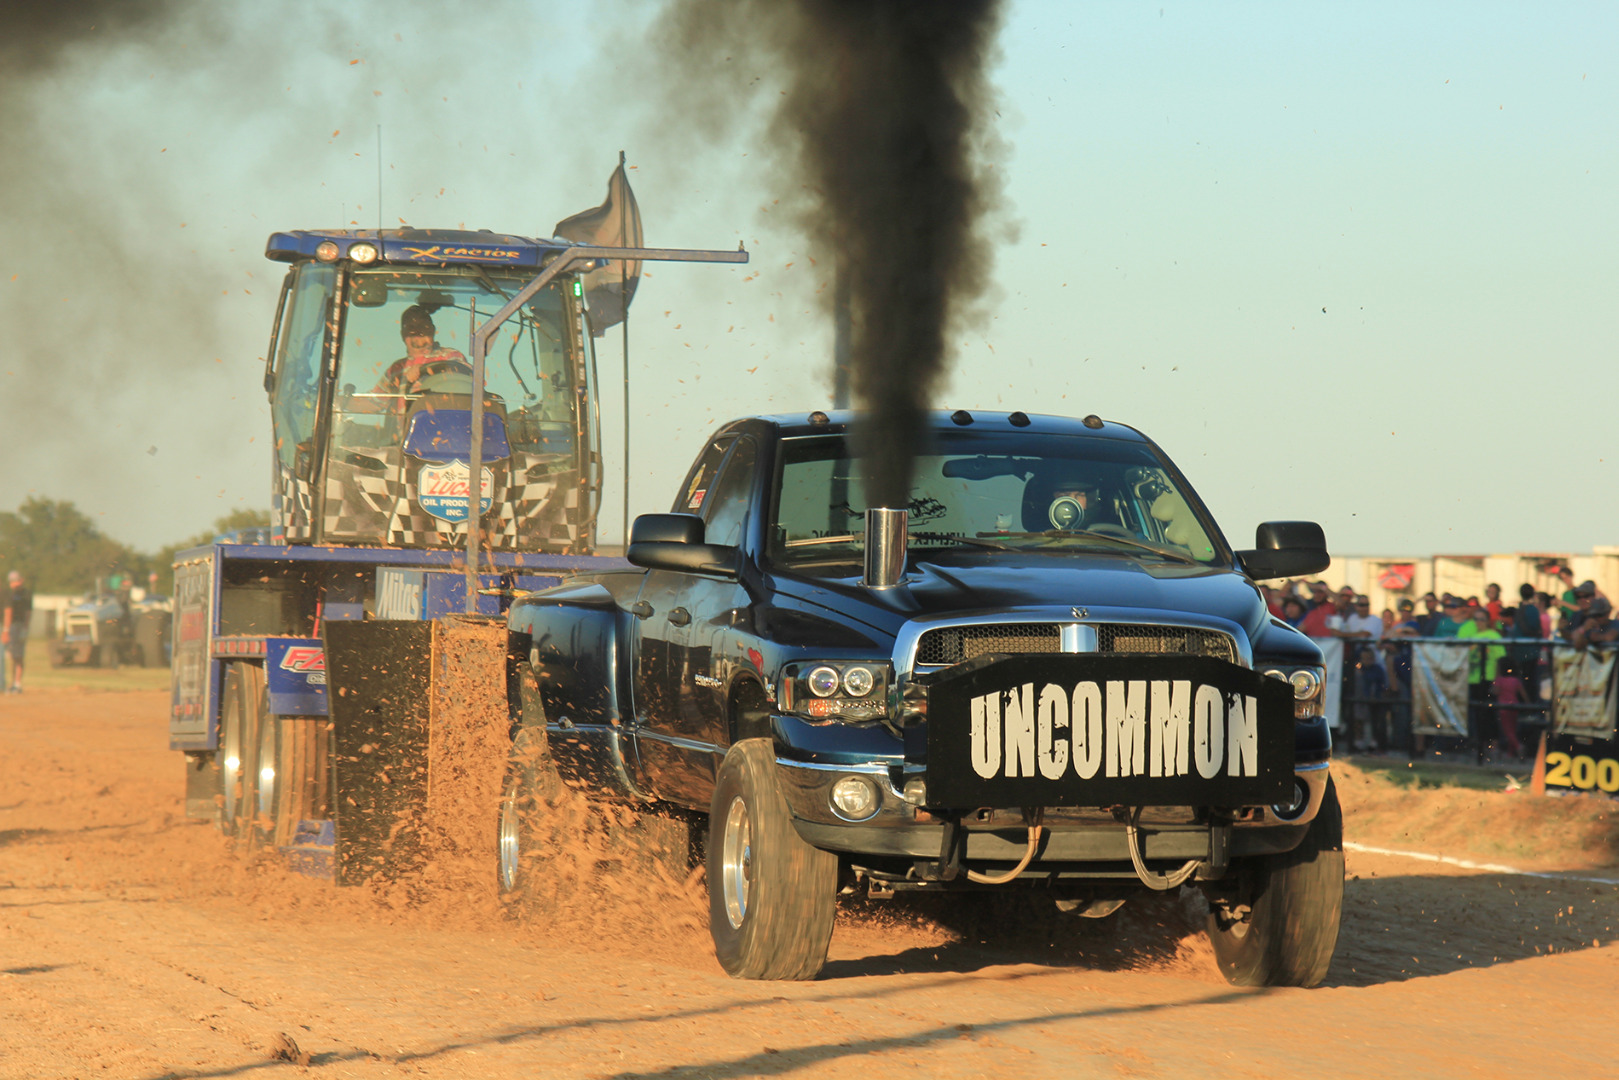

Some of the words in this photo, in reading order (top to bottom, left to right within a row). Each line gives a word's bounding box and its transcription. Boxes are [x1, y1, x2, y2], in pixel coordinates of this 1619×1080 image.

[401, 246, 441, 260] X
[443, 248, 520, 259] FACTOR
[422, 498, 438, 507] OIL
[445, 509, 464, 517] INC.
[970, 680, 1258, 780] UNCOMMON
[1545, 751, 1619, 792] 200
